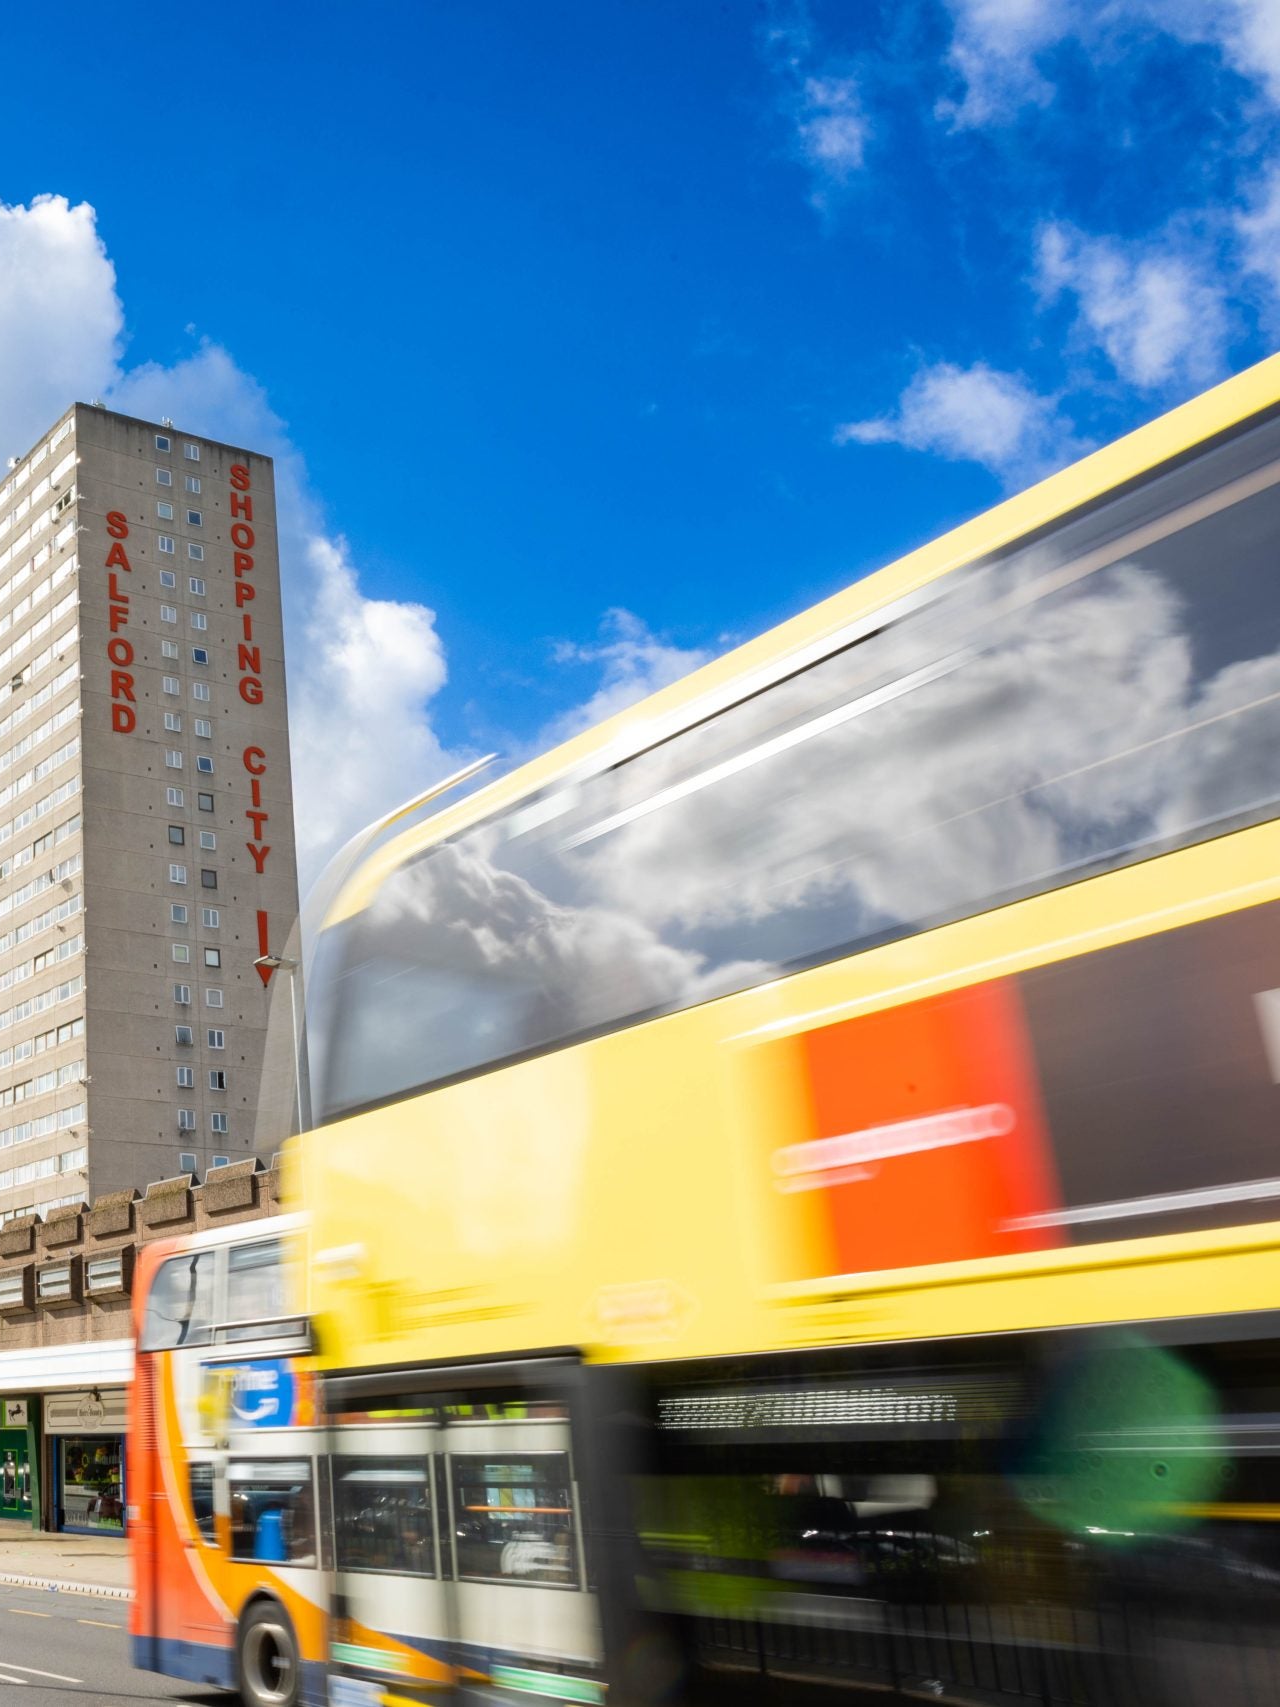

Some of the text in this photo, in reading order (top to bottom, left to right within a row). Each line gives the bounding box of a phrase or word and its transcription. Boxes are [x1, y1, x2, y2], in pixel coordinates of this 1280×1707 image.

[105, 511, 136, 733] SALFORD
[230, 464, 271, 874] SHOPPING CITY
